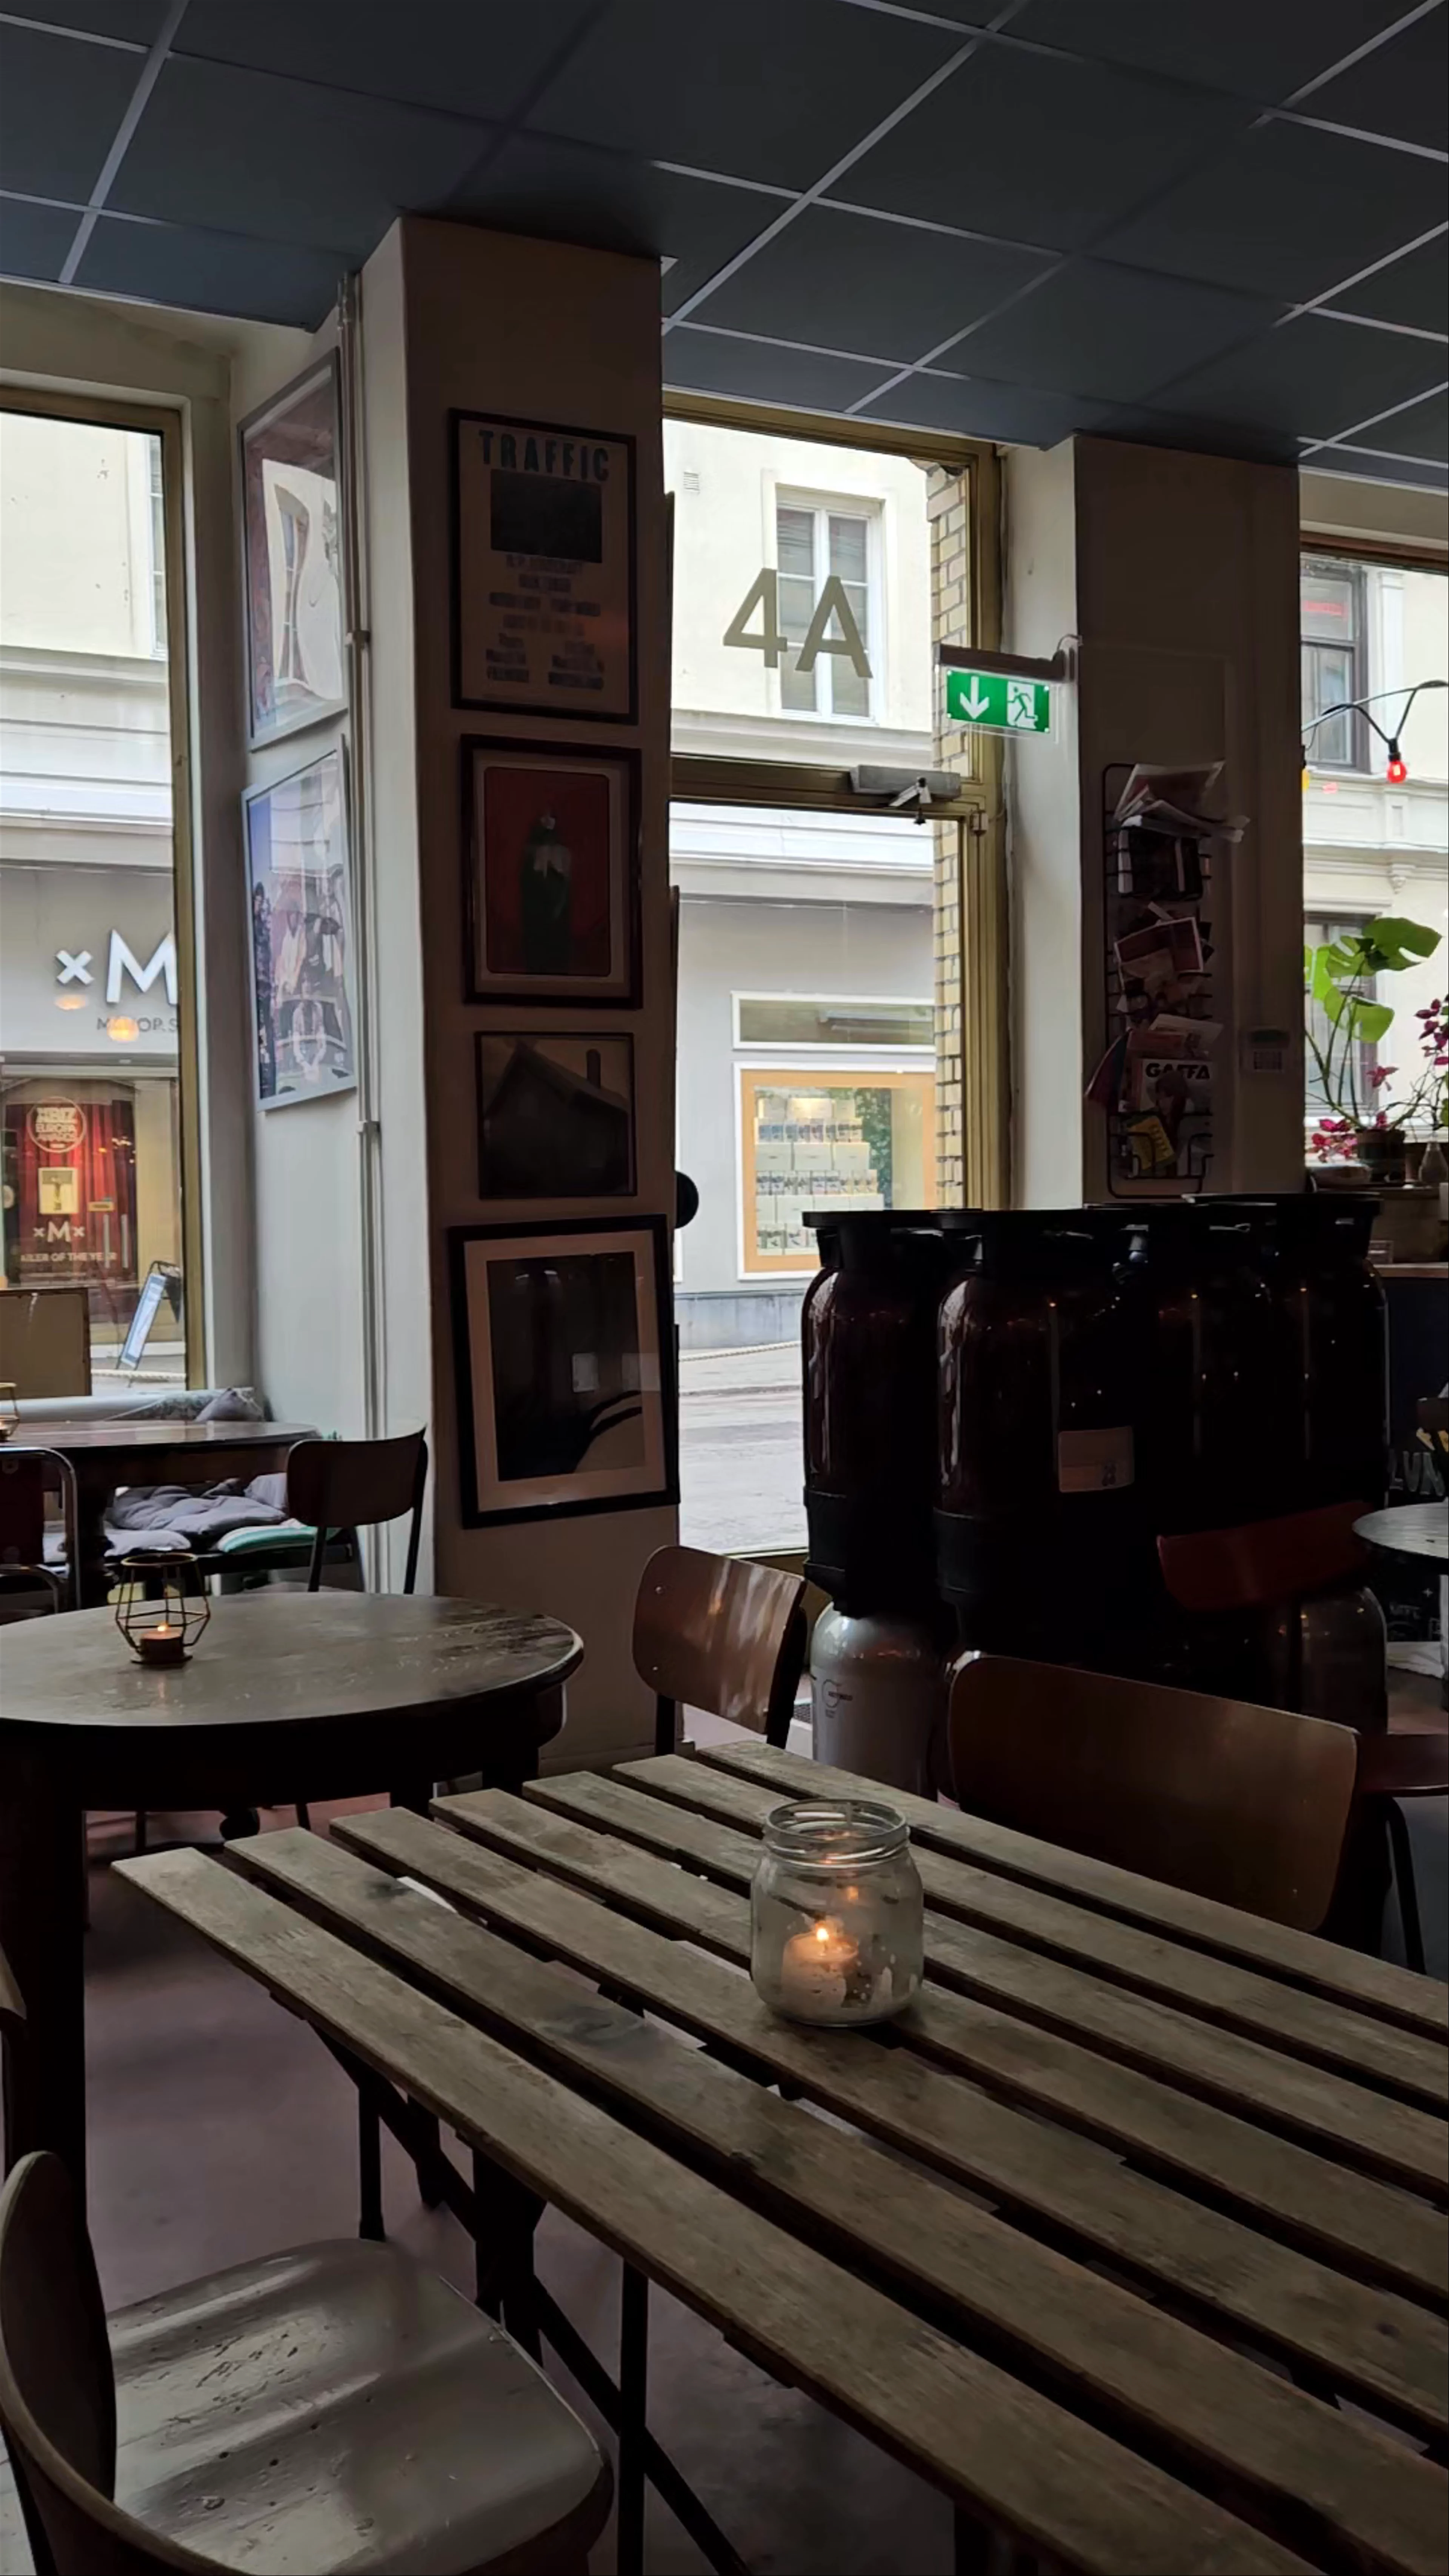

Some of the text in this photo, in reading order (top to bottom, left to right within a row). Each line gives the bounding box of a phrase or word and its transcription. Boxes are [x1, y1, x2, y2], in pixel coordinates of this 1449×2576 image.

[479, 429, 609, 481] TRAFFIC
[723, 567, 873, 678] 4A
[50, 1252, 65, 1261] OF
[68, 1252, 87, 1261] THE
